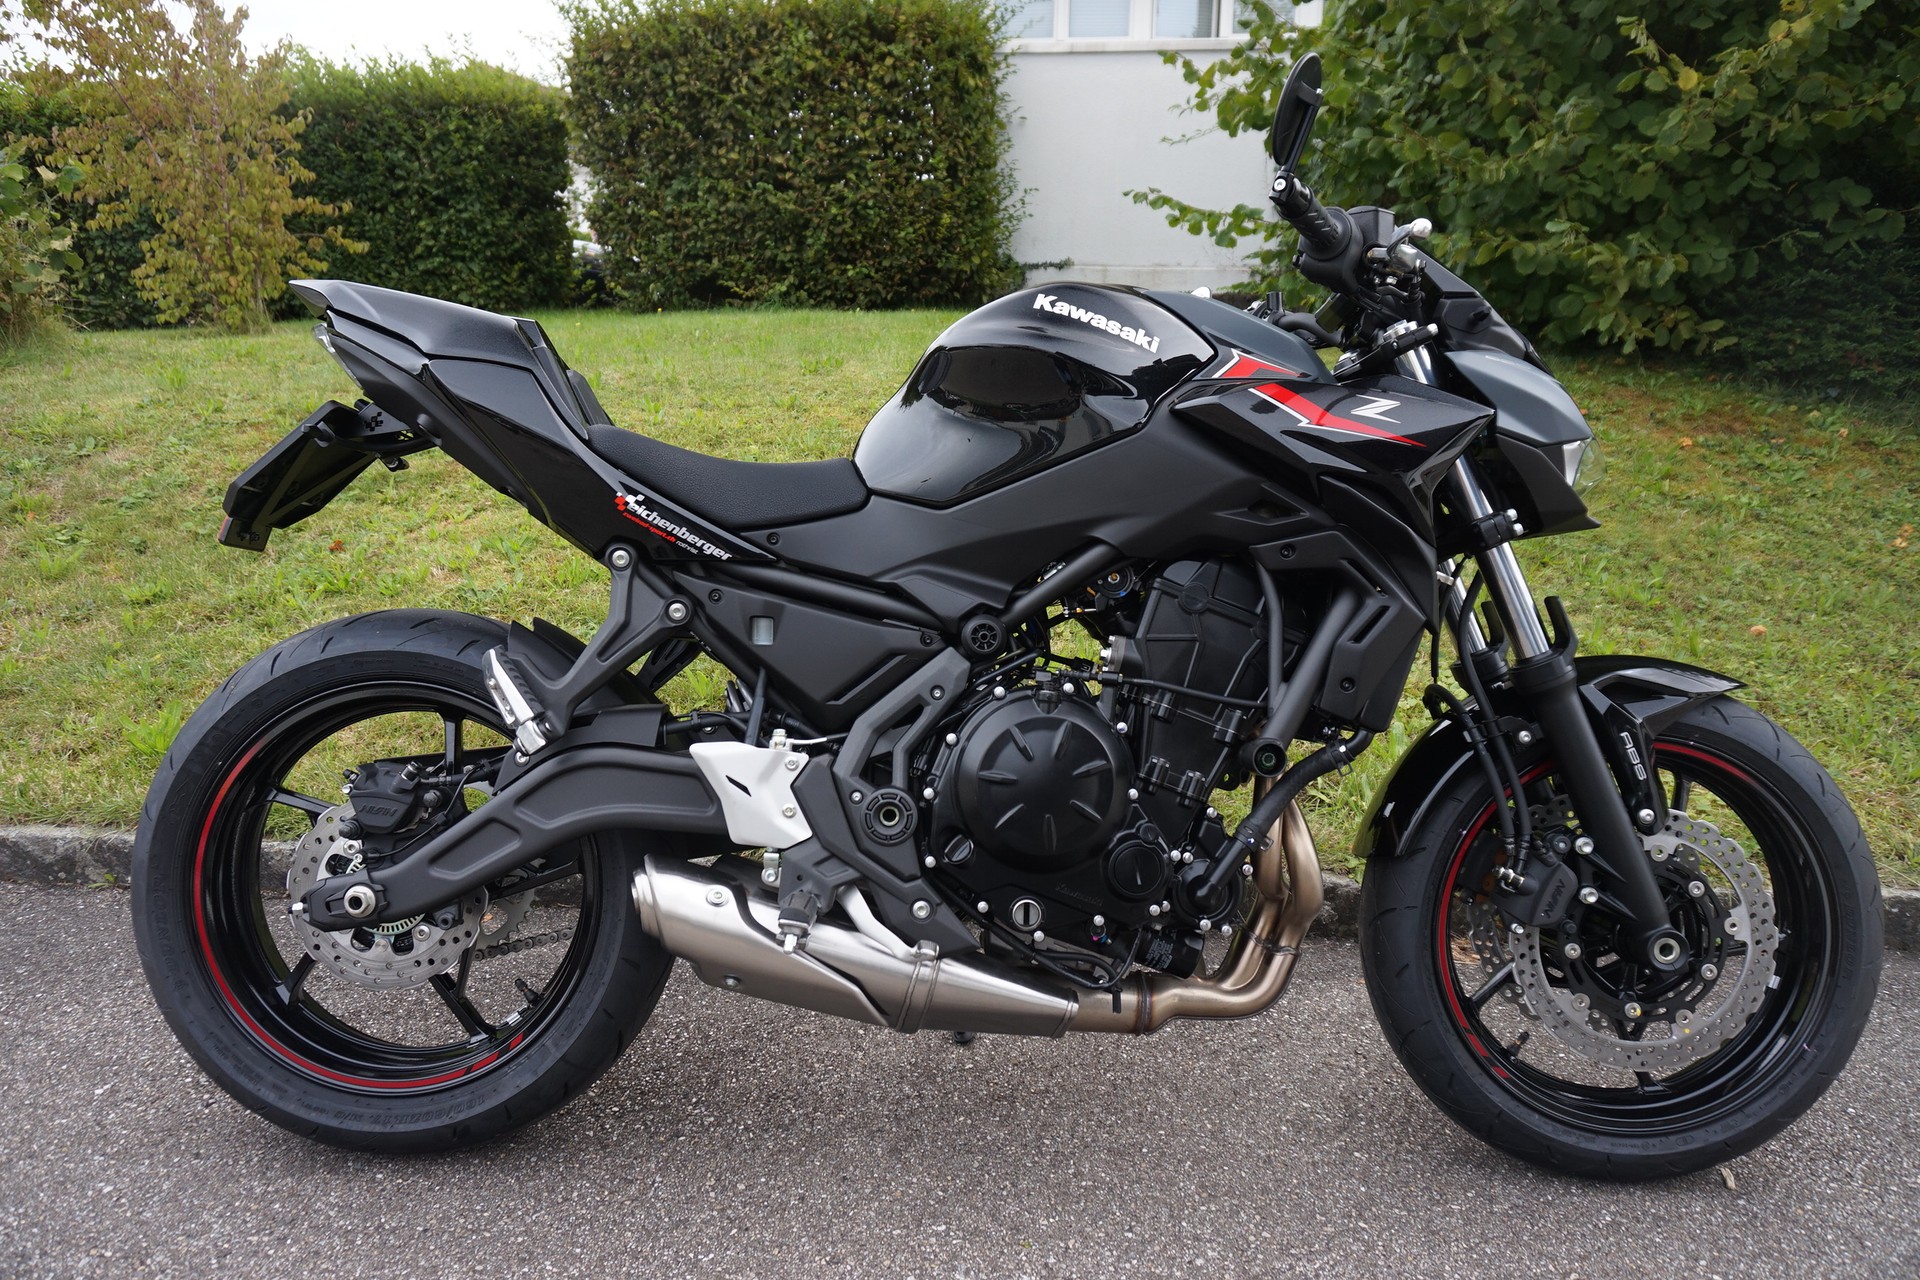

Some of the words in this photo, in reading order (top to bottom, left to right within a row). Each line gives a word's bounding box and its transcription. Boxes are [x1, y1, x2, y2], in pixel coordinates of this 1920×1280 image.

[1033, 293, 1160, 354] Kawasaki
[1350, 394, 1401, 424] Z
[626, 502, 732, 561] eichenberger
[1620, 731, 1648, 781] ABS
